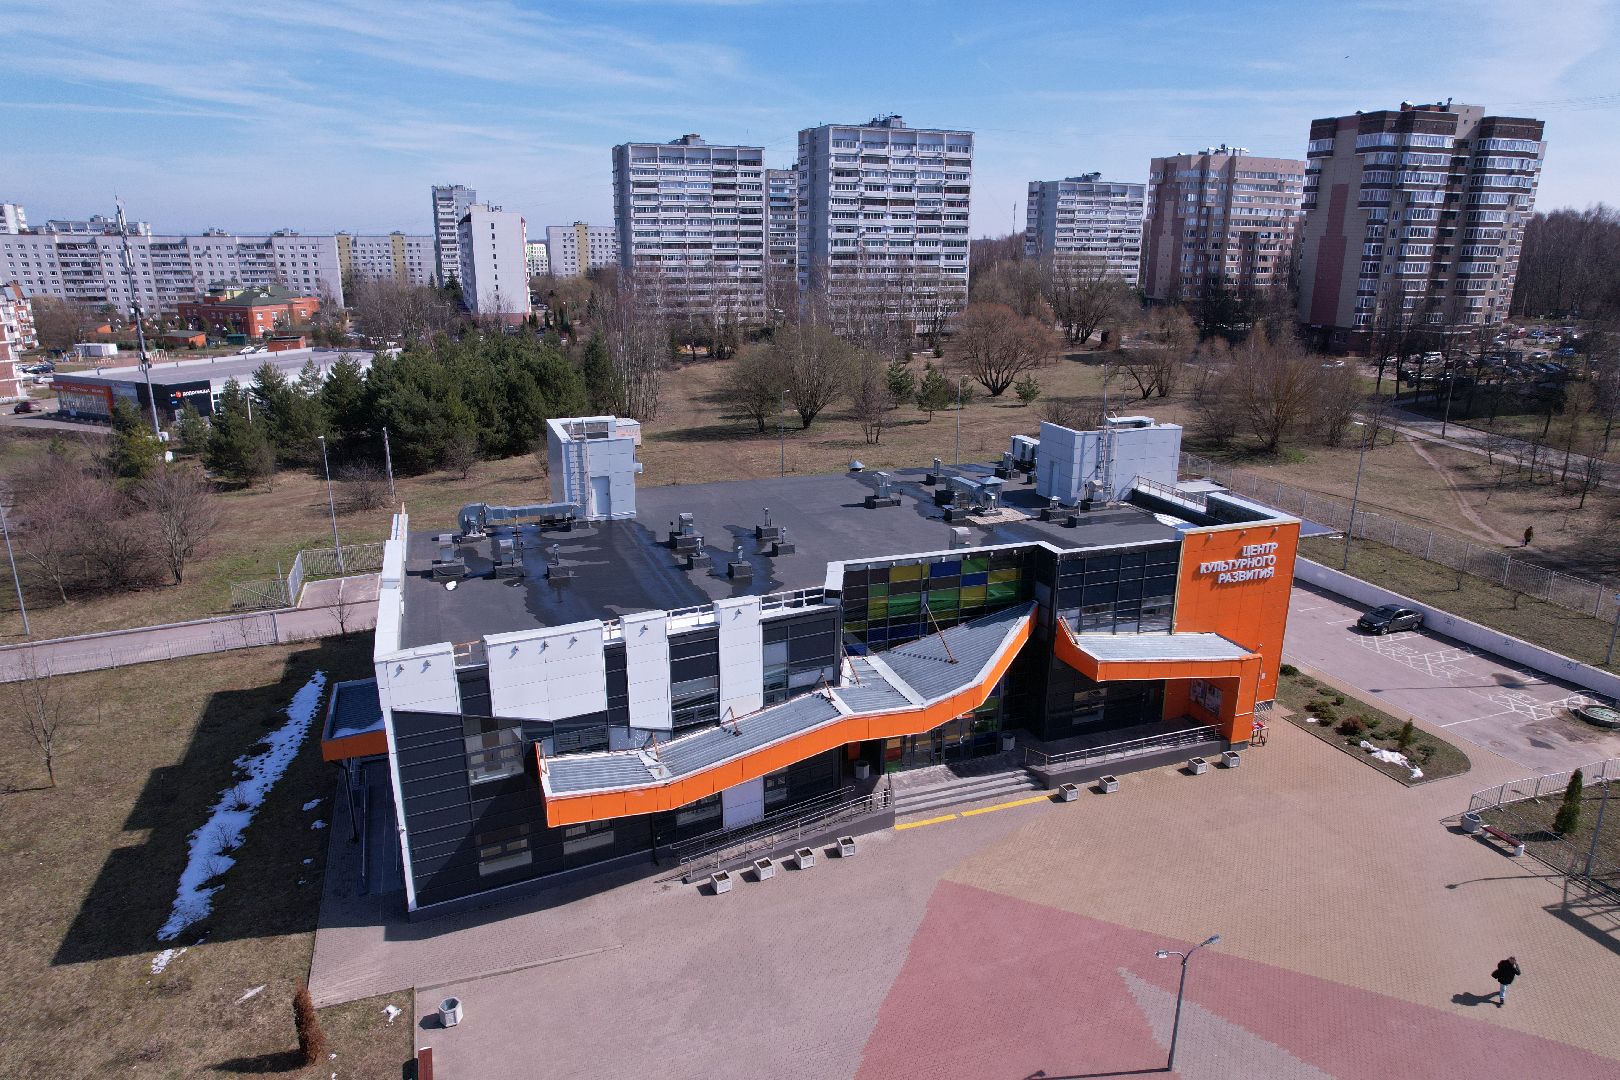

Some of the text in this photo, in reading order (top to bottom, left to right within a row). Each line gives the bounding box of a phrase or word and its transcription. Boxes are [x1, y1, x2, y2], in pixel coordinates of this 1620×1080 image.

[1243, 542, 1278, 556] ЦЕНТР
[1200, 555, 1276, 573] КУЛЬТУРНОГО
[1218, 567, 1274, 583] РАЗВИТИЯ
